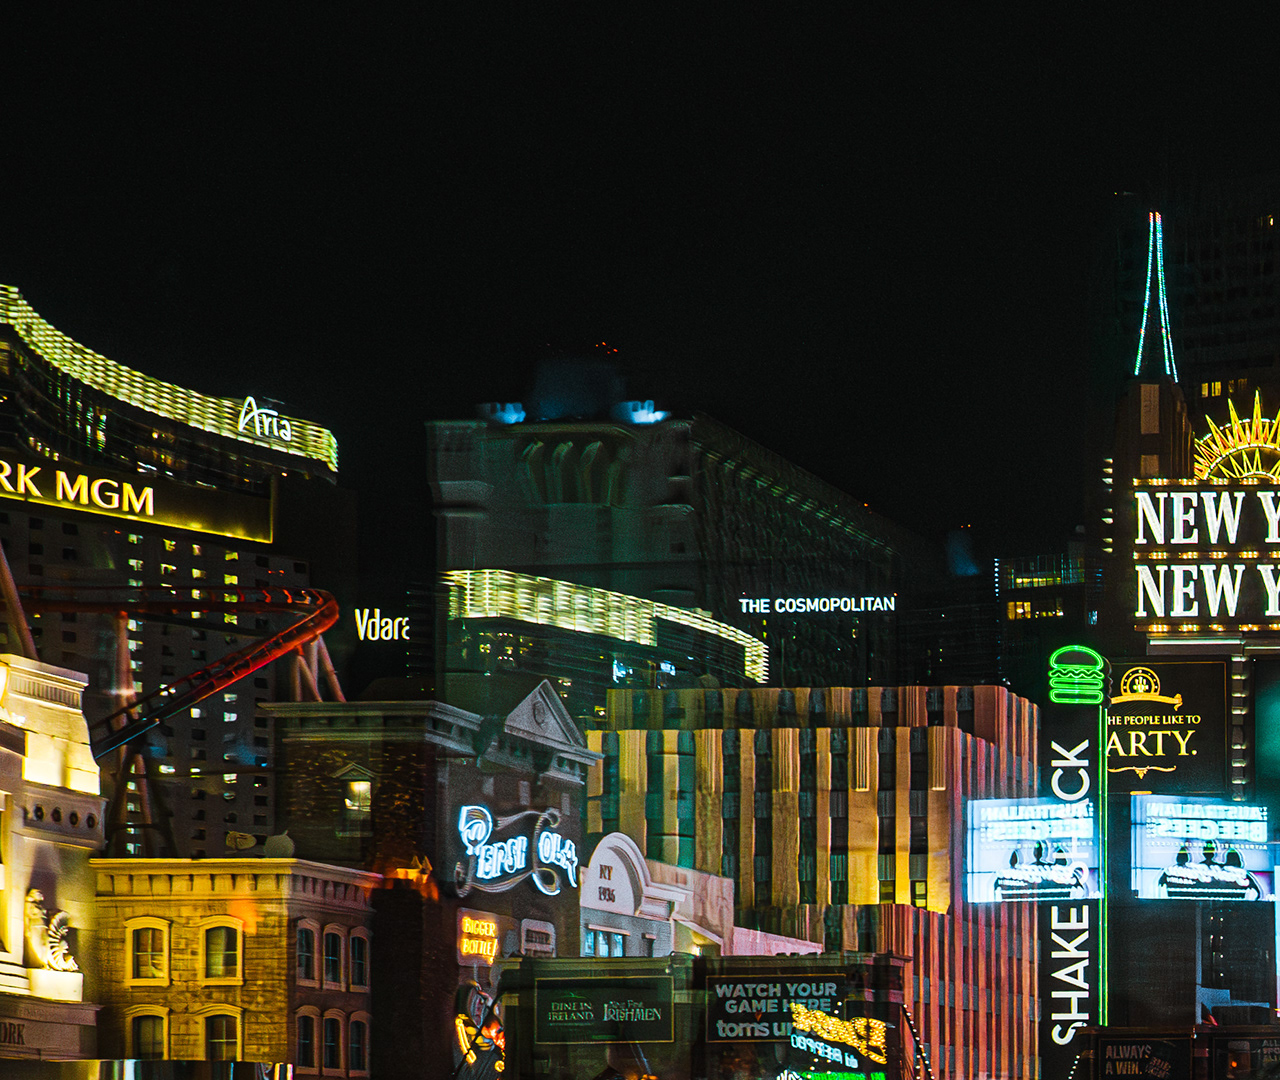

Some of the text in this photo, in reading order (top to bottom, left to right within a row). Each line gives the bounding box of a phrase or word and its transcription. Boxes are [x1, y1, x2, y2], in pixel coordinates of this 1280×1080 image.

[238, 396, 292, 441] Aria
[56, 469, 154, 516] MGM
[1135, 490, 1245, 545] NEW
[1135, 563, 1245, 618] NEW
[739, 596, 895, 613] THE COSMOPOLITAN
[1107, 714, 1201, 726] HE PEOPLE LIKE TO
[1051, 739, 1089, 885] SHACK
[599, 863, 613, 881] NY
[462, 916, 496, 937] BIGGER
[1051, 904, 1089, 1046] SHAKE
[715, 982, 837, 998] WATCH YOUR
[551, 1001, 592, 1010] DINE IN
[602, 1003, 662, 1022] IRISHMEN
[725, 998, 831, 1013] GAME HERE
[548, 1011, 594, 1021] IRELAND
[716, 1019, 770, 1037] toms
[1105, 1044, 1152, 1060] ALWAYS
[1105, 1062, 1114, 1075] A
[1116, 1062, 1143, 1076] WIN.
